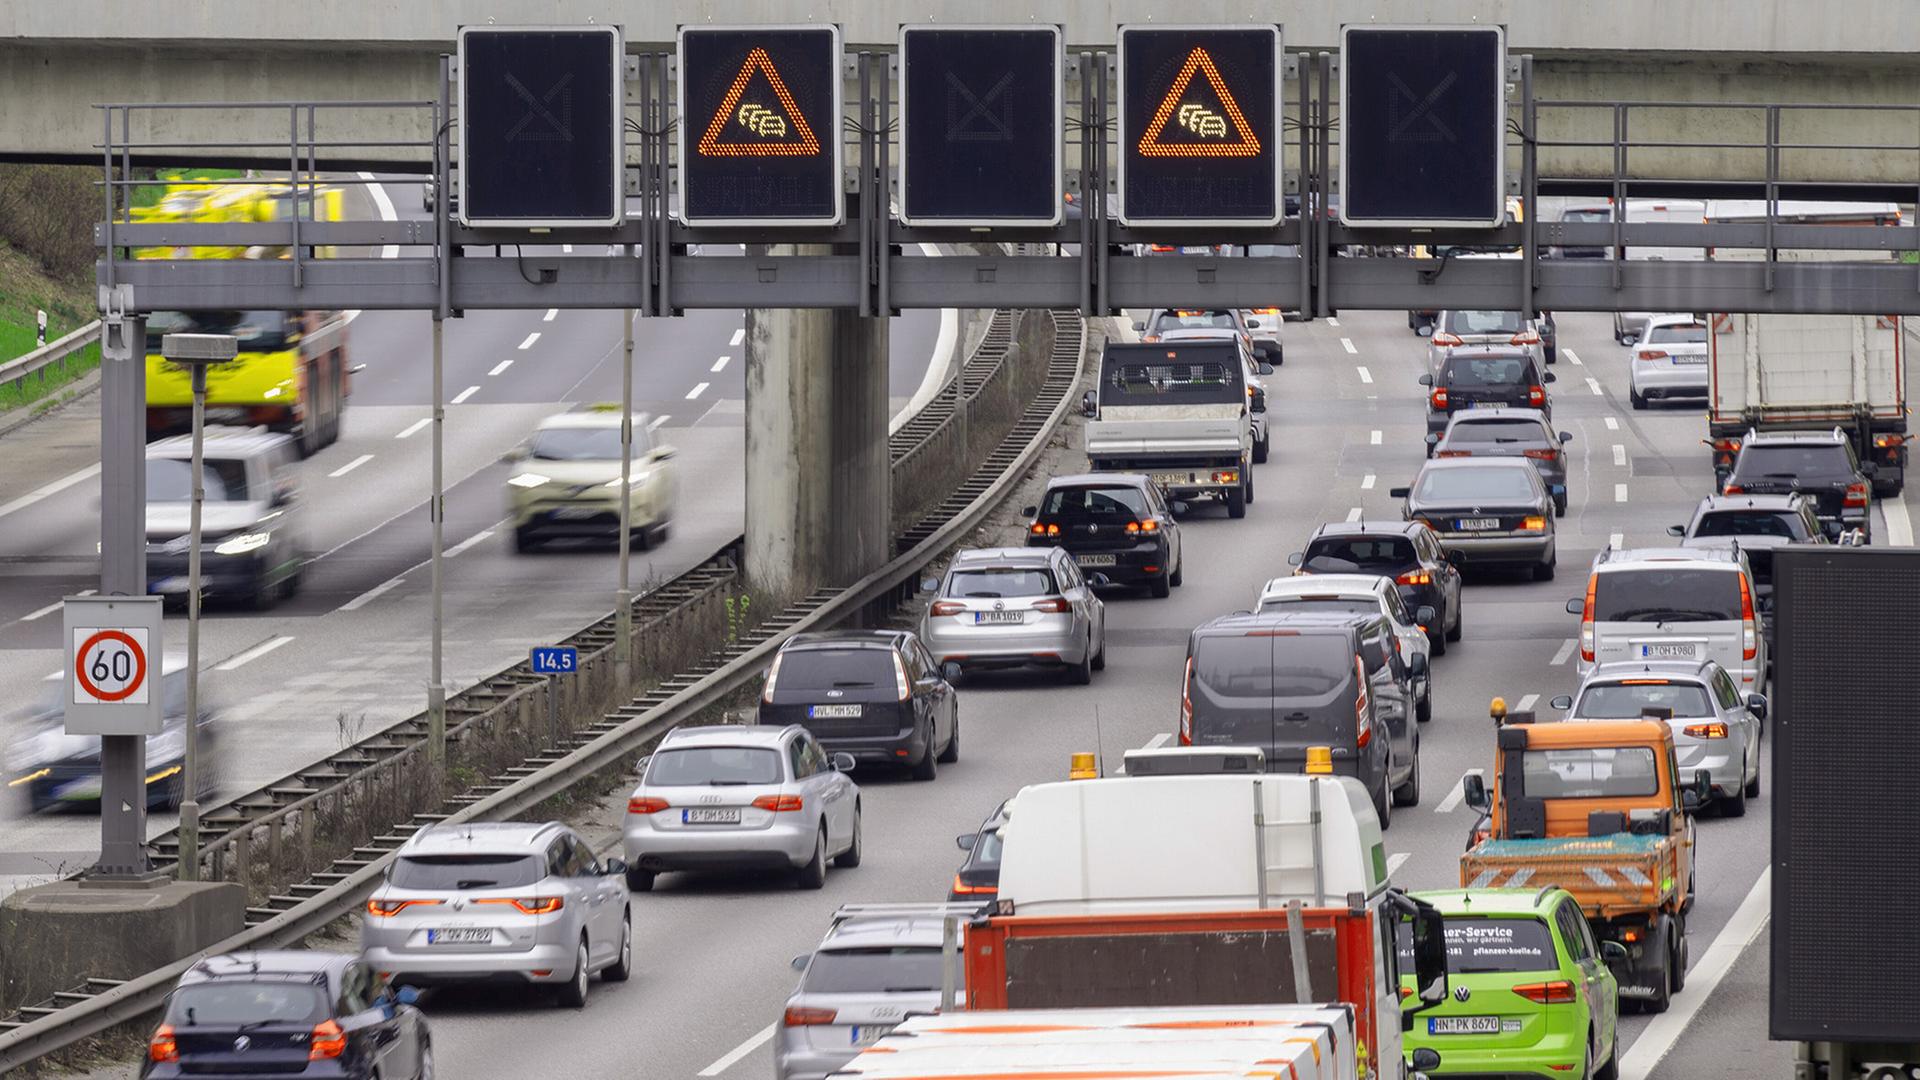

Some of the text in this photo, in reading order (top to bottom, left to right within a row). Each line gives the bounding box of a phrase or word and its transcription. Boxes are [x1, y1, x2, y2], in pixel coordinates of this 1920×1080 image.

[1002, 611, 1022, 621] 1019
[1672, 646, 1692, 656] 1980
[92, 650, 130, 682] 60
[538, 652, 571, 670] 14.5
[1436, 1018, 1449, 1030] HN
[1456, 1018, 1469, 1030] PK
[1472, 1017, 1497, 1030] 8670
